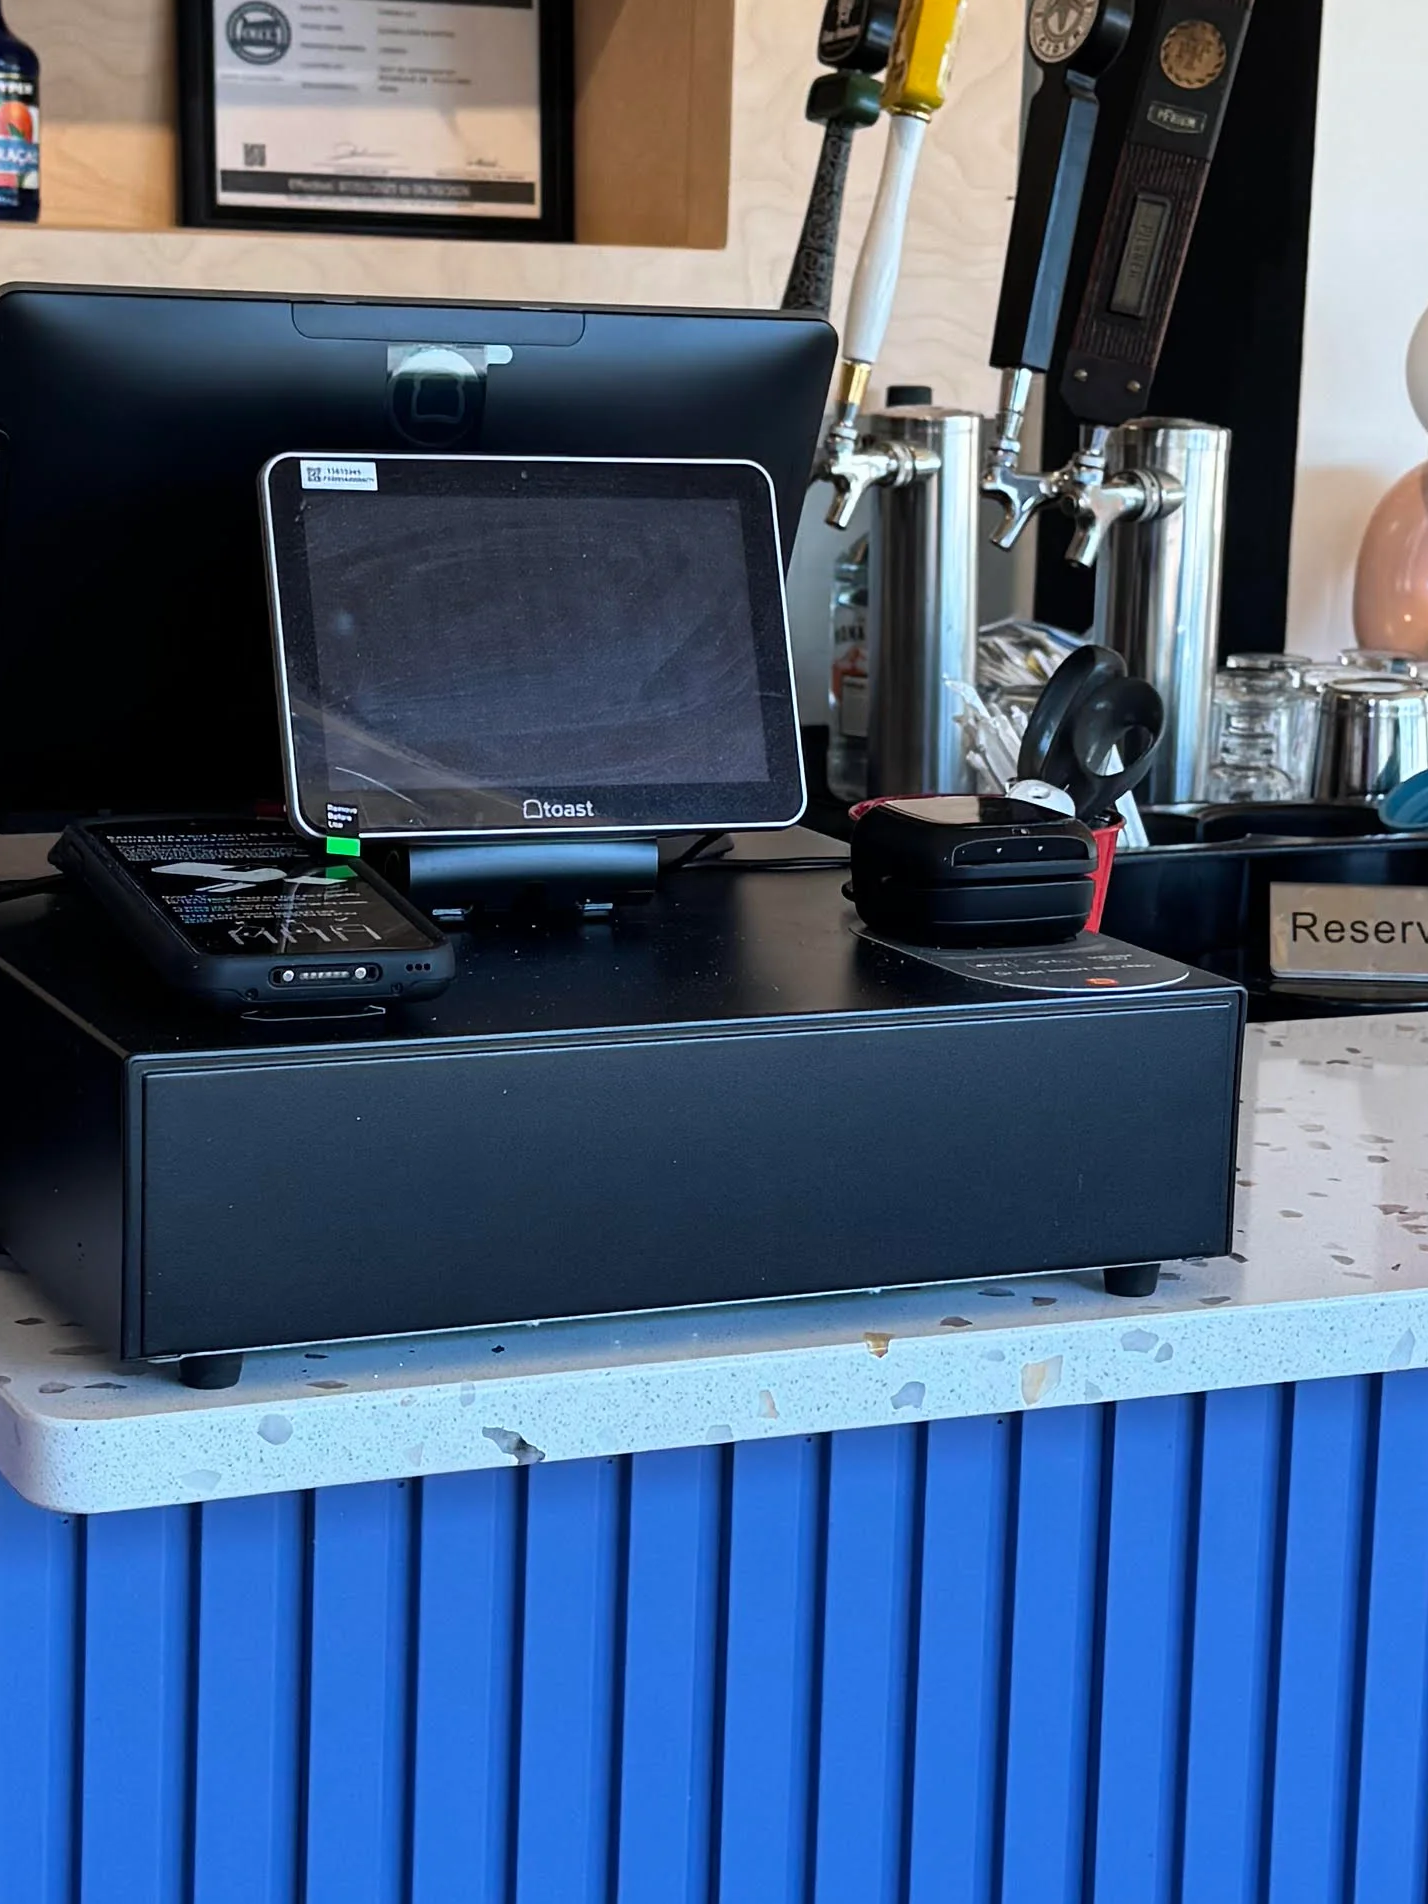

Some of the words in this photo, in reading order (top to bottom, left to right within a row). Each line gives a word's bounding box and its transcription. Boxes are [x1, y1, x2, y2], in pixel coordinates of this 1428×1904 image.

[1036, 26, 1085, 55] CIDER
[1129, 223, 1155, 279] PILSNER
[543, 800, 595, 817] toast
